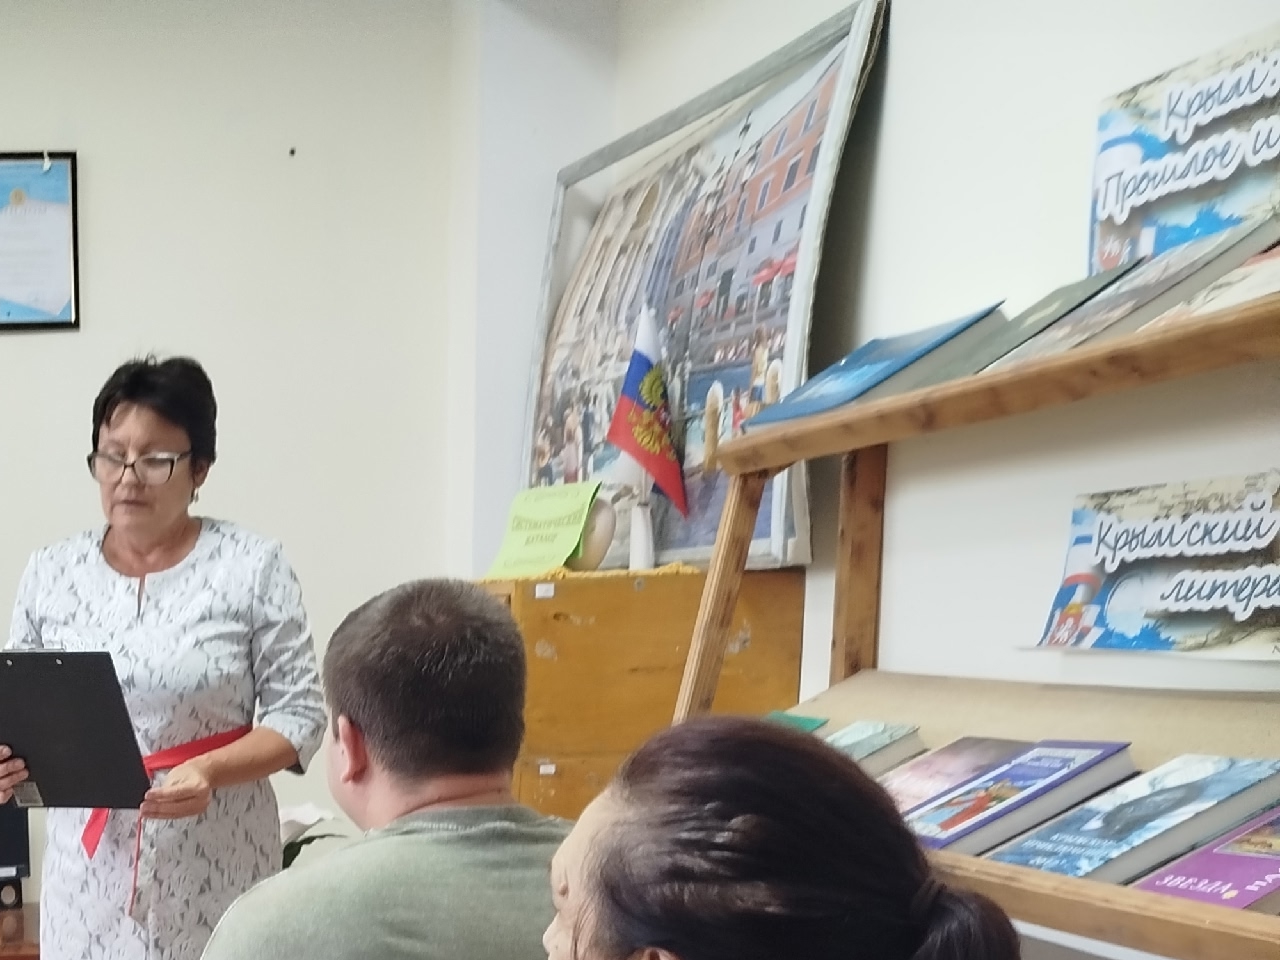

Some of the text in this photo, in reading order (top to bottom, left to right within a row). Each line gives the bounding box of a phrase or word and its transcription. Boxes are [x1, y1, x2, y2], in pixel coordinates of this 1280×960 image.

[1164, 57, 1279, 134] Крым:
[1101, 137, 1241, 214] Прошлое
[1094, 499, 1276, 564] Крымский
